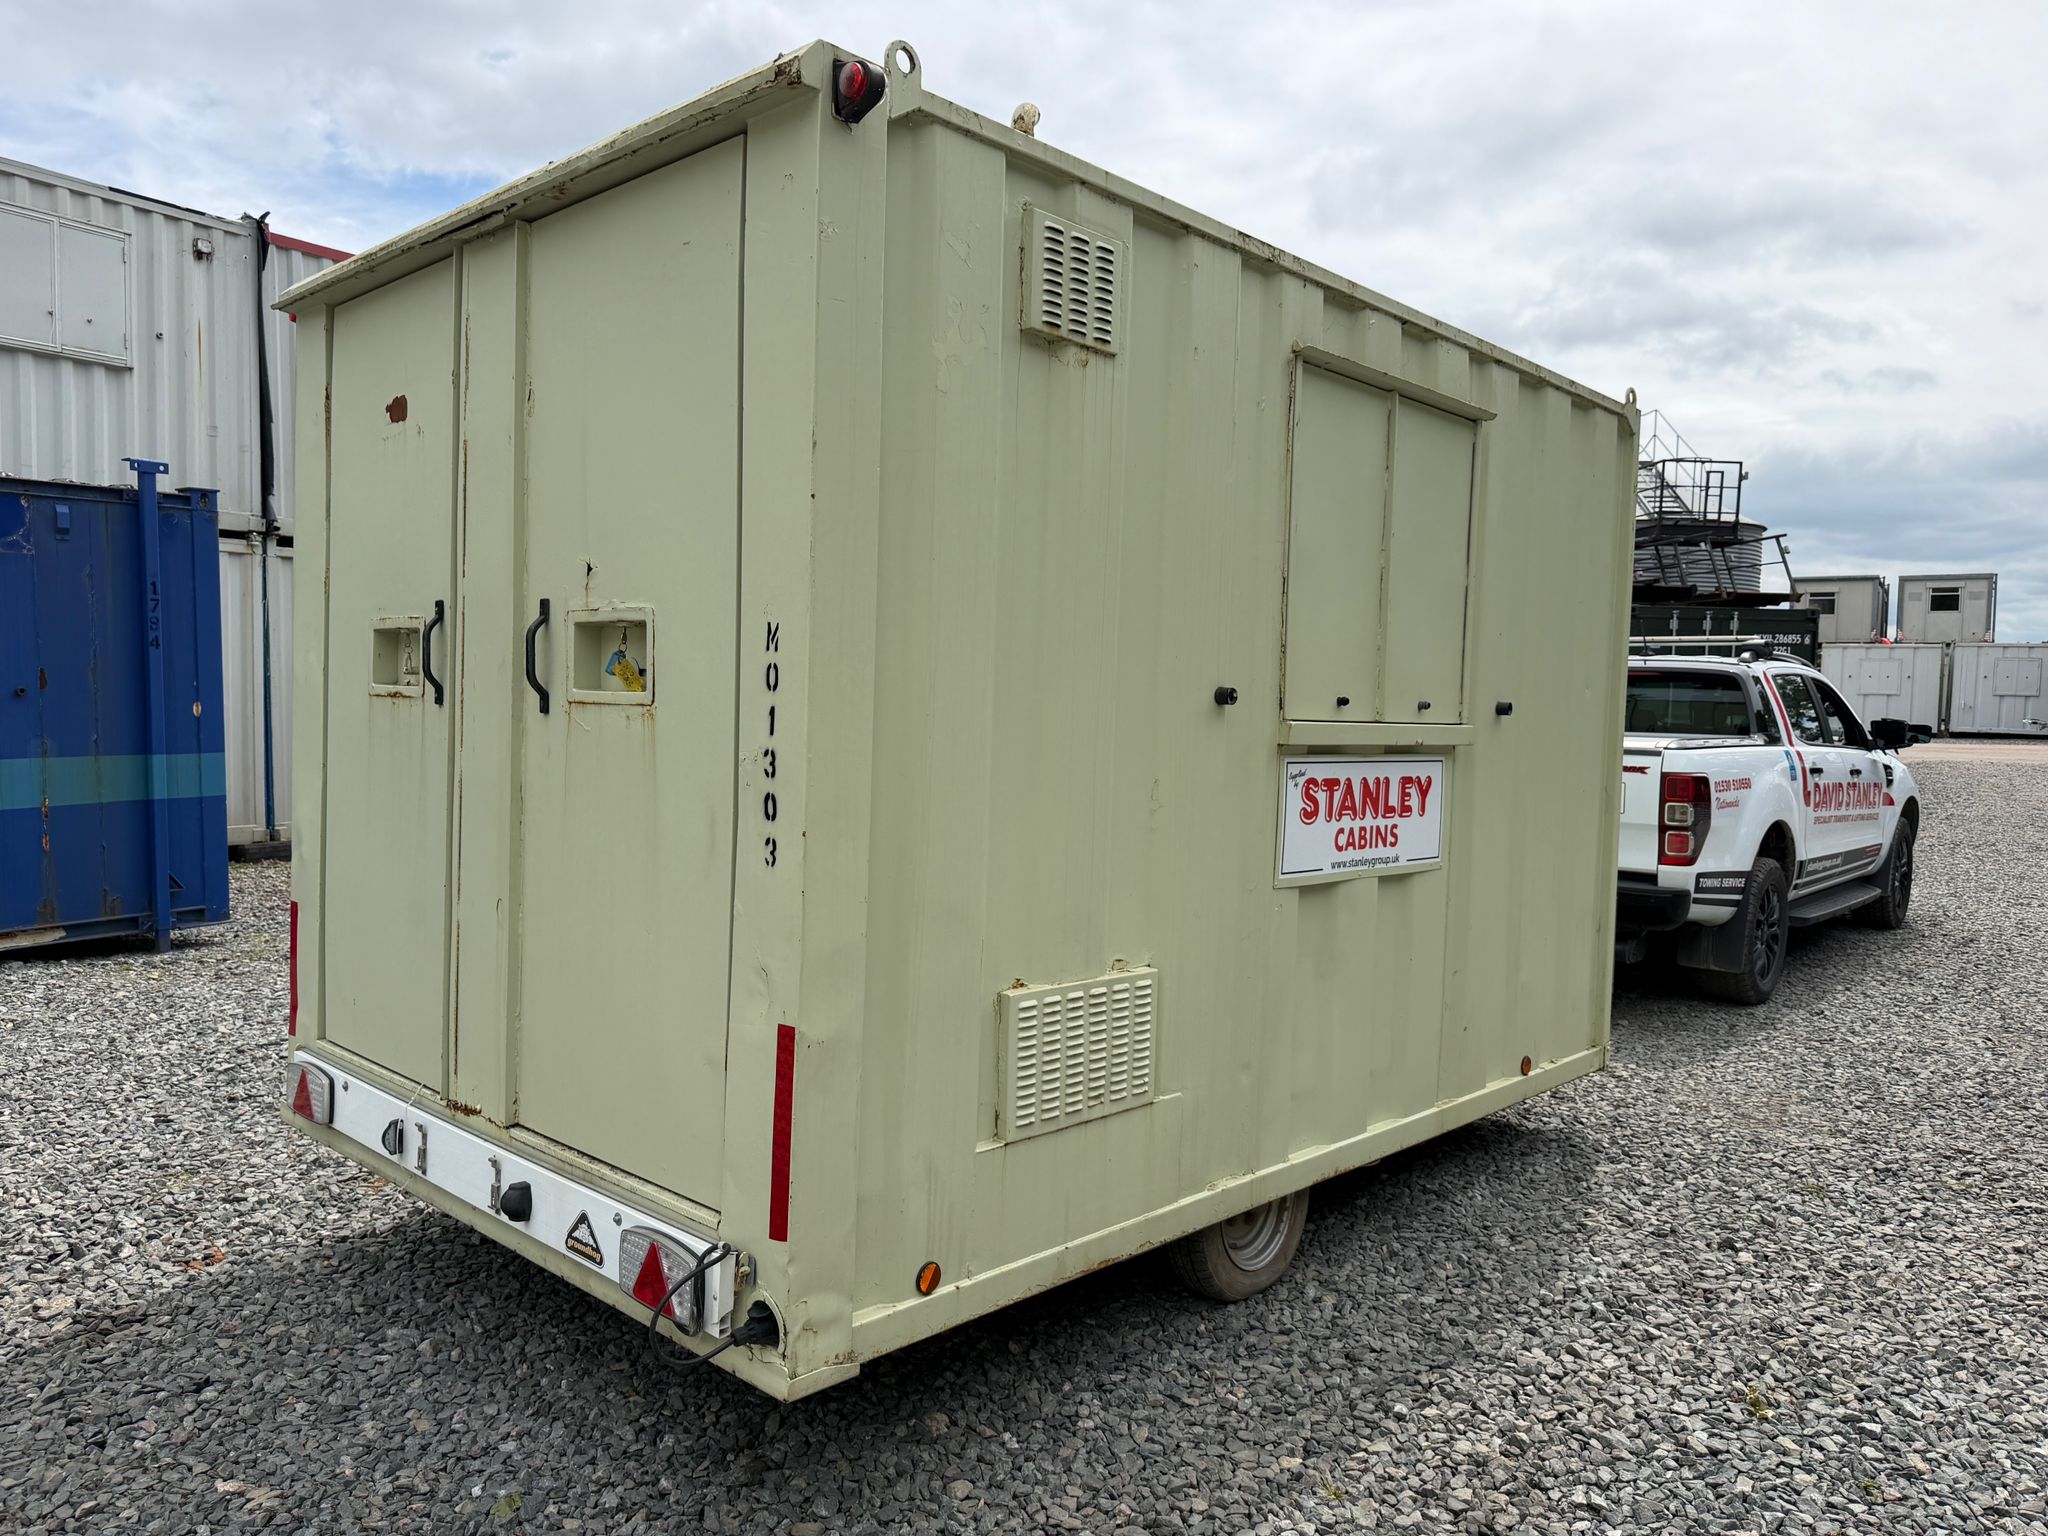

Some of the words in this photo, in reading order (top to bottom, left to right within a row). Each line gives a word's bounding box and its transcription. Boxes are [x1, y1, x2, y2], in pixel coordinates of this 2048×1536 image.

[1774, 634, 1801, 644] 286855
[1299, 775, 1433, 826] STANLEY
[1813, 782, 1844, 812] DAVID
[1845, 781, 1882, 811] STANLEY
[1334, 823, 1399, 853] CABINS
[1330, 853, 1400, 870] www.stanleygroup.uk
[1699, 877, 1721, 888] TOWING
[1722, 877, 1746, 888] SERVICE
[567, 1238, 601, 1262] groundhog
